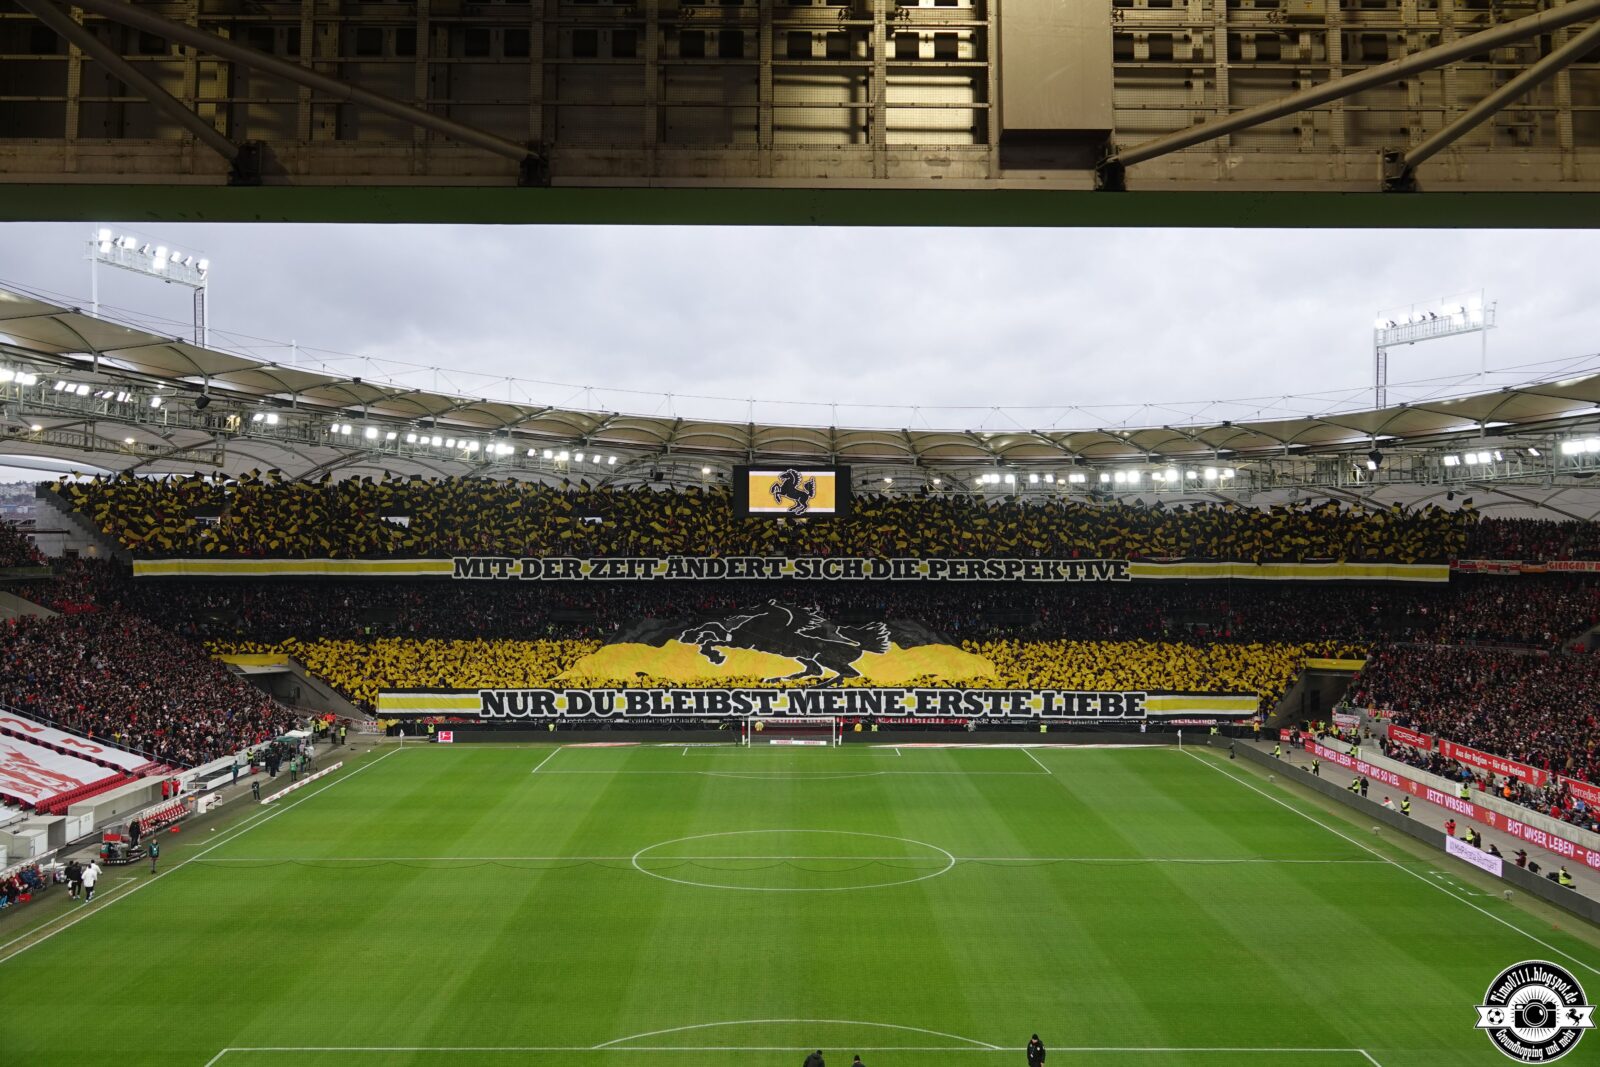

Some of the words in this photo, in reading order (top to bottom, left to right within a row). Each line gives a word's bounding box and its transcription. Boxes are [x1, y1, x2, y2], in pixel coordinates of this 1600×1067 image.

[452, 557, 515, 579] MIT
[519, 557, 584, 579] DER
[588, 557, 659, 579] ZEIT
[665, 556, 787, 579] ÄNDERT
[793, 558, 865, 581] SICH
[869, 558, 921, 581] DIE
[927, 558, 1130, 582] PERSPEKTIVE
[480, 690, 559, 718] NUR
[564, 690, 618, 718] DU
[624, 690, 781, 719] BLEIBST
[787, 689, 906, 719] MEINE
[914, 690, 1034, 719] ERSTE
[1041, 690, 1147, 720] LIEBE
[1393, 729, 1425, 745] PORSCHE
[1337, 752, 1352, 767] LEBEN
[1381, 770, 1388, 781] SO
[1388, 773, 1400, 786] VIEL
[1455, 748, 1464, 758] Aus
[1464, 751, 1472, 760] der
[1472, 753, 1487, 765] Region
[1493, 759, 1501, 769] für
[1509, 765, 1526, 777] Region
[1426, 788, 1444, 805] JETZT
[1507, 819, 1523, 837] BIST
[1524, 826, 1548, 848] UNSER
[1549, 836, 1575, 857] LEBEN
